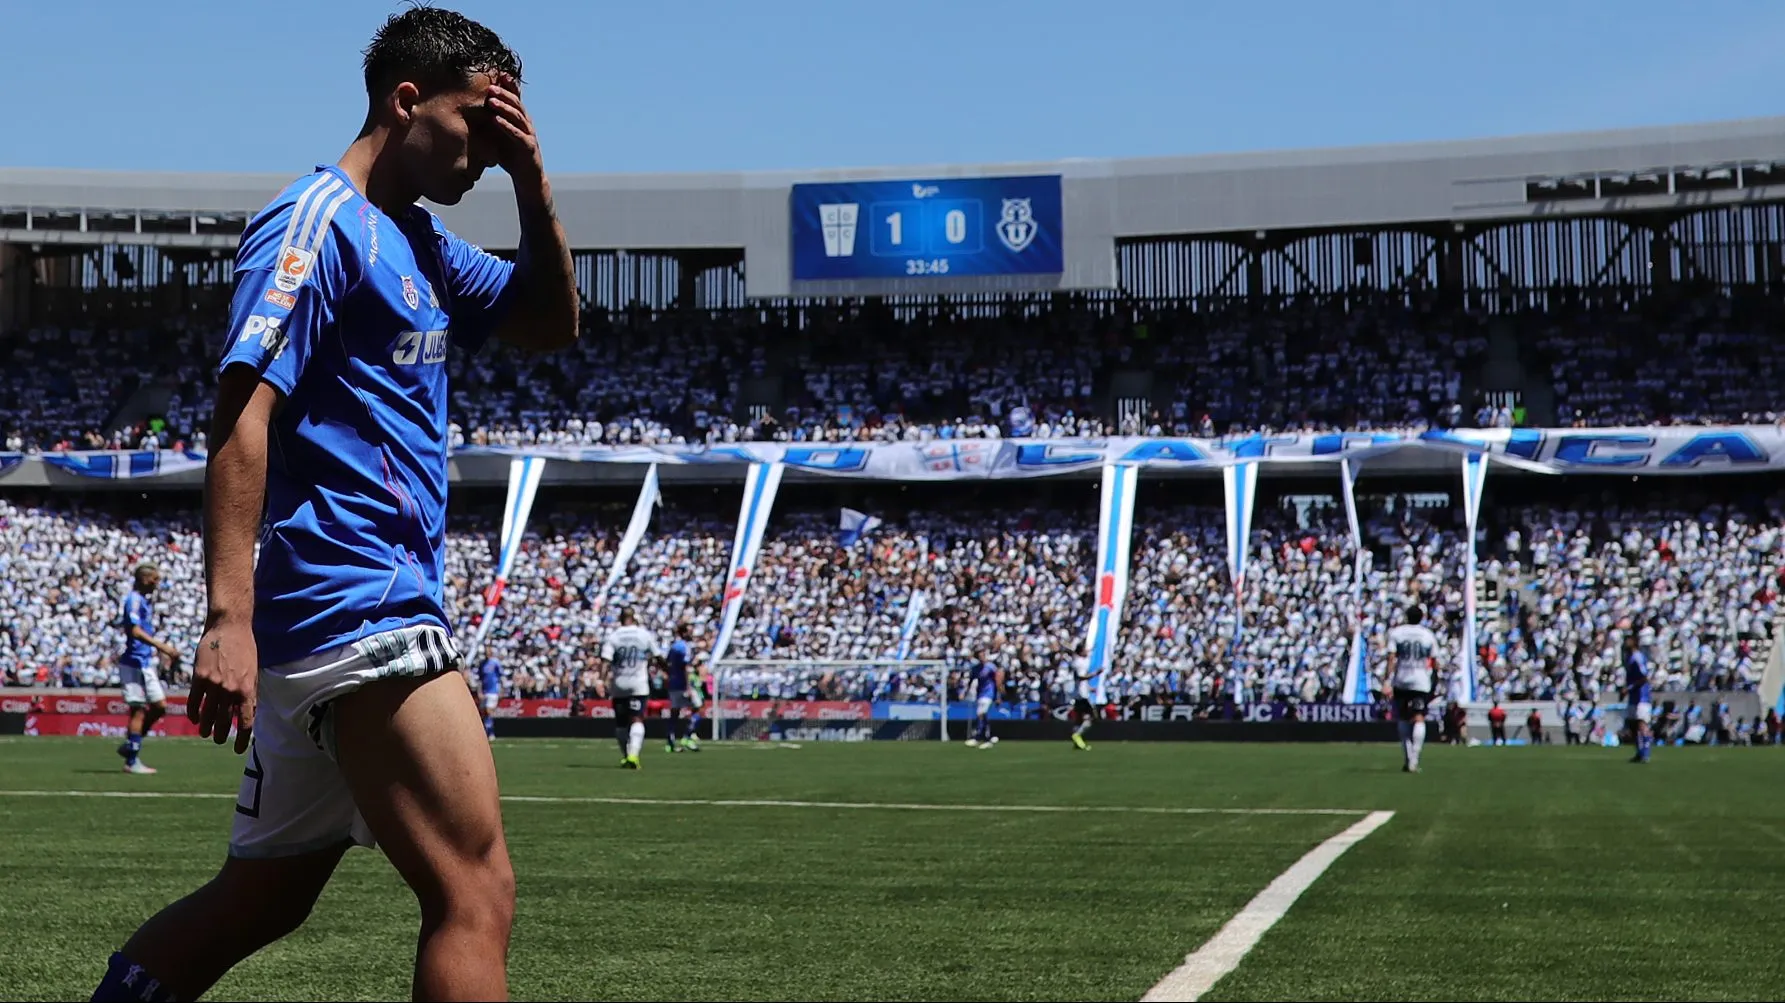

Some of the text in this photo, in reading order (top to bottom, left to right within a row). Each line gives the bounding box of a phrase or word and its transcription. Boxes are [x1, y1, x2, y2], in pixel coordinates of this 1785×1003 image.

[886, 209, 966, 245] 1 0
[906, 259, 949, 275] 33:45
